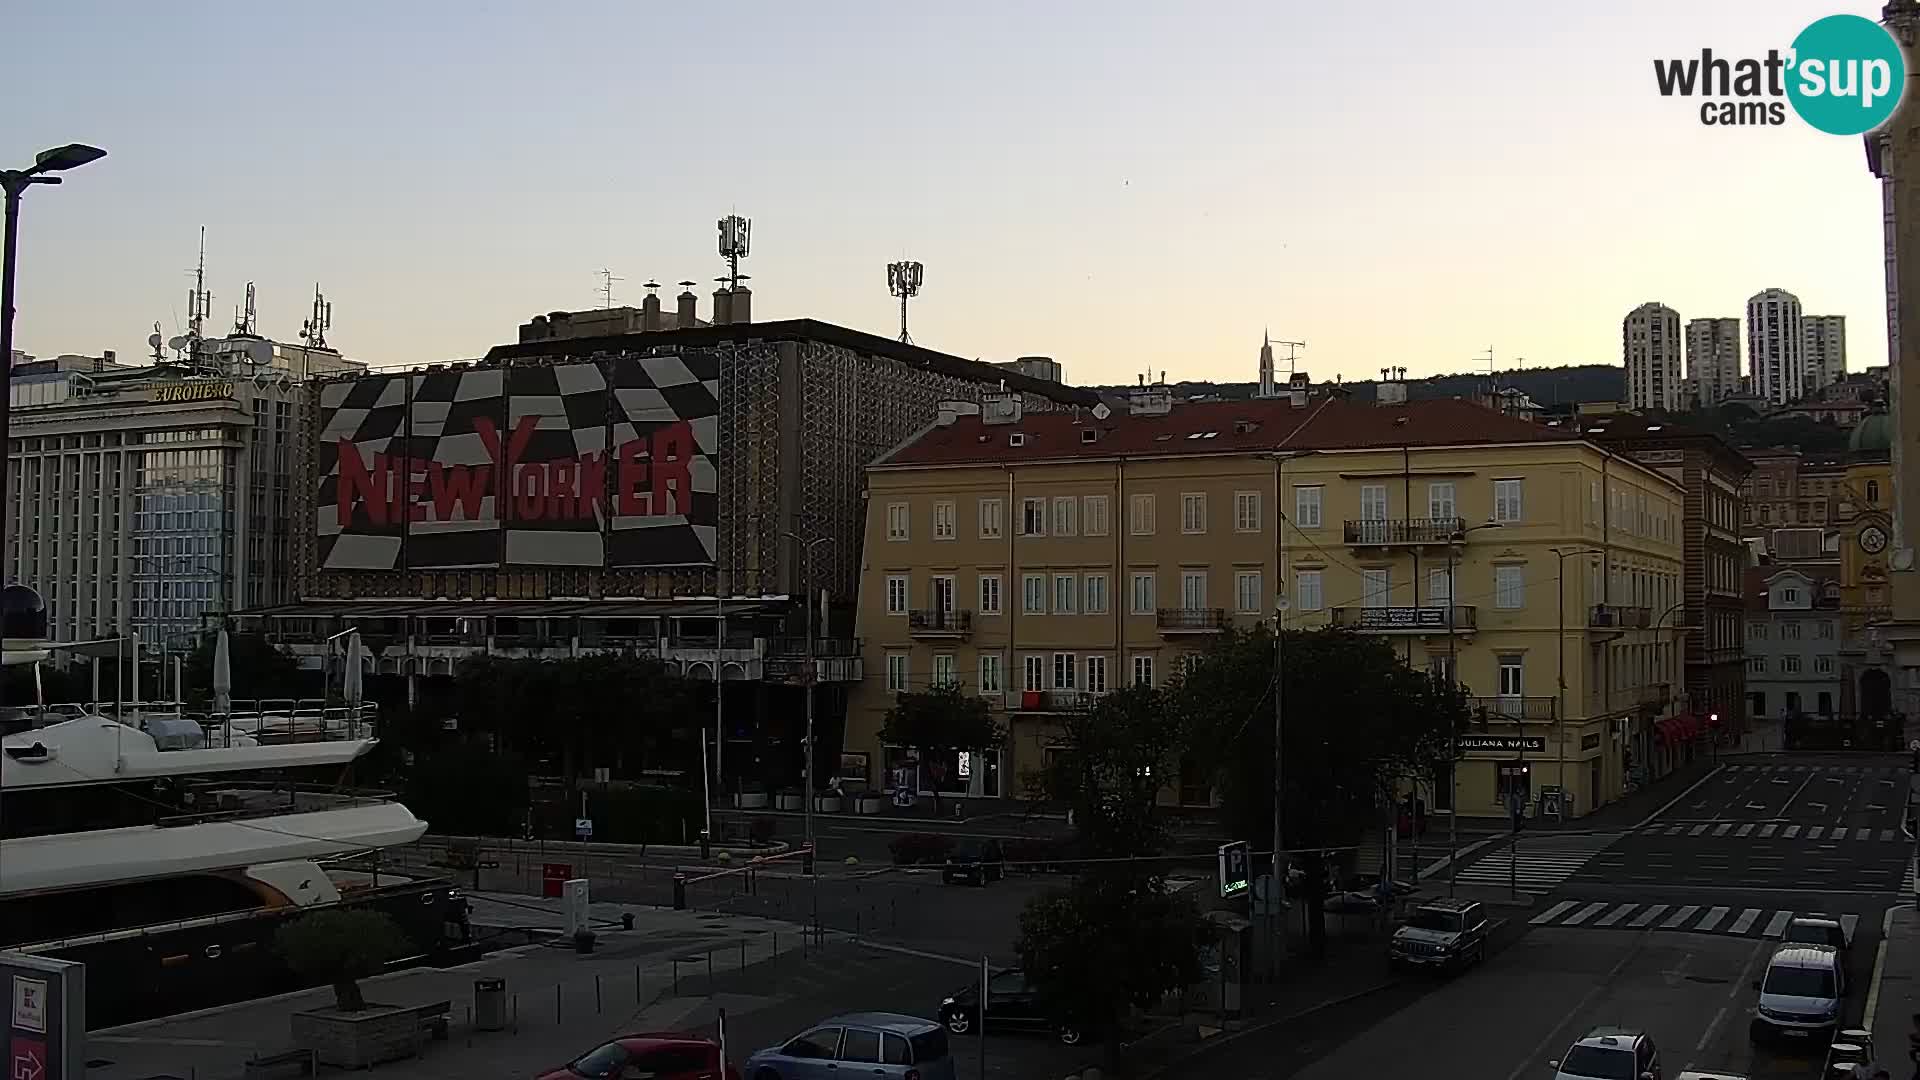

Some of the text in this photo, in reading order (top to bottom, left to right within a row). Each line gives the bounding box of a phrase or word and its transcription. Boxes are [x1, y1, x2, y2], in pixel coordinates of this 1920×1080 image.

[336, 415, 699, 529] NEW YORKER
[1507, 739, 1540, 749] NAILS
